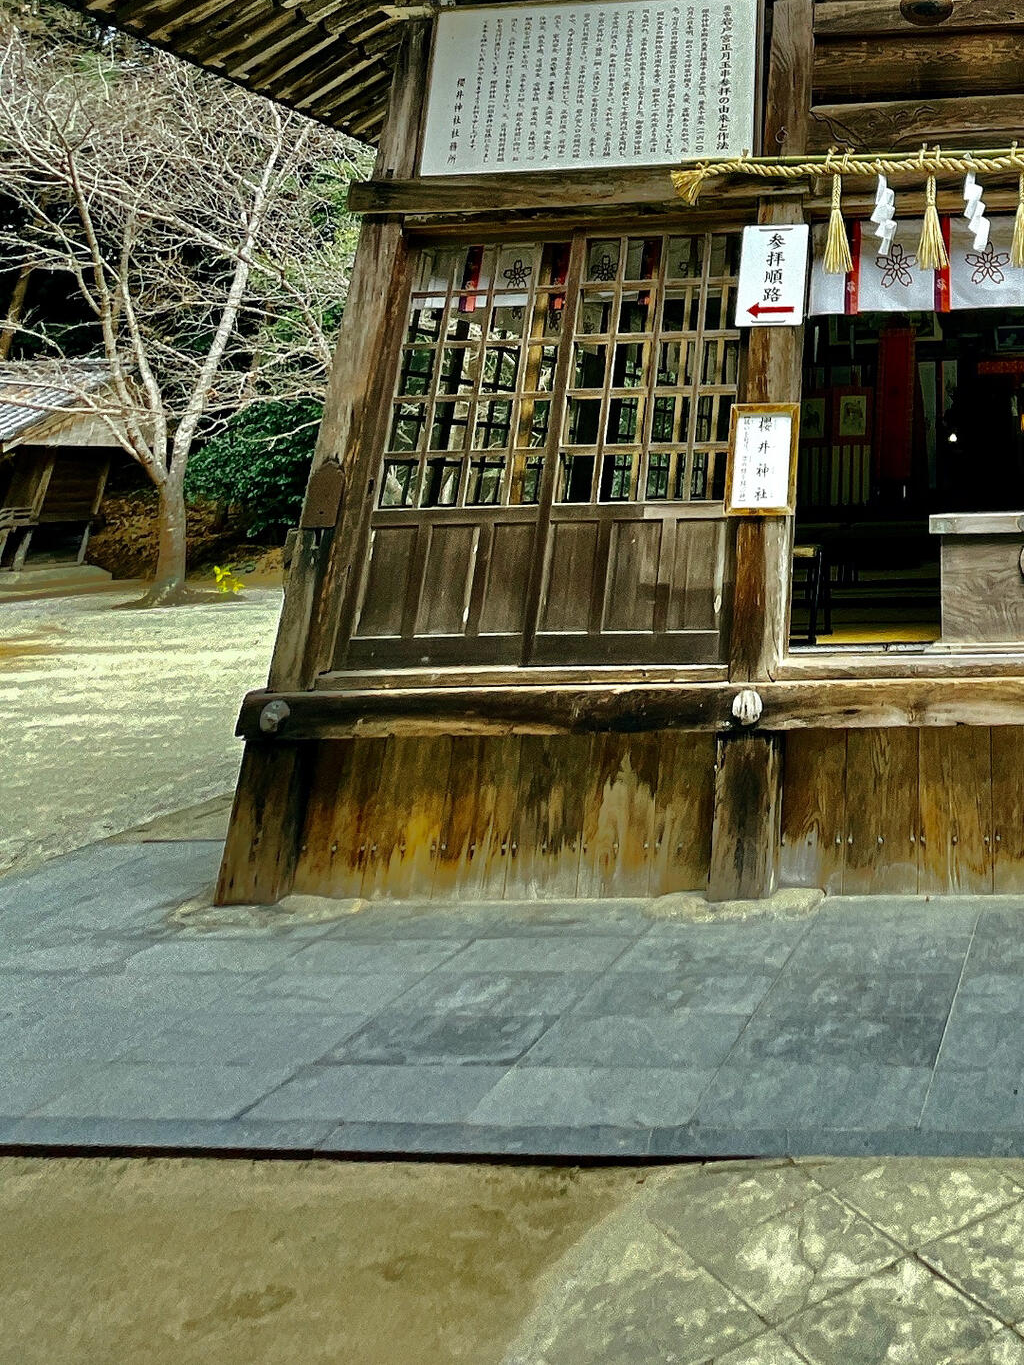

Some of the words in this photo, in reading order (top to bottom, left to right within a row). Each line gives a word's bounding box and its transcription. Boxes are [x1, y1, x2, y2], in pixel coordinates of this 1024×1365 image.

[762, 234, 787, 303] 参拝順路
[754, 416, 773, 502] 櫻井神社
